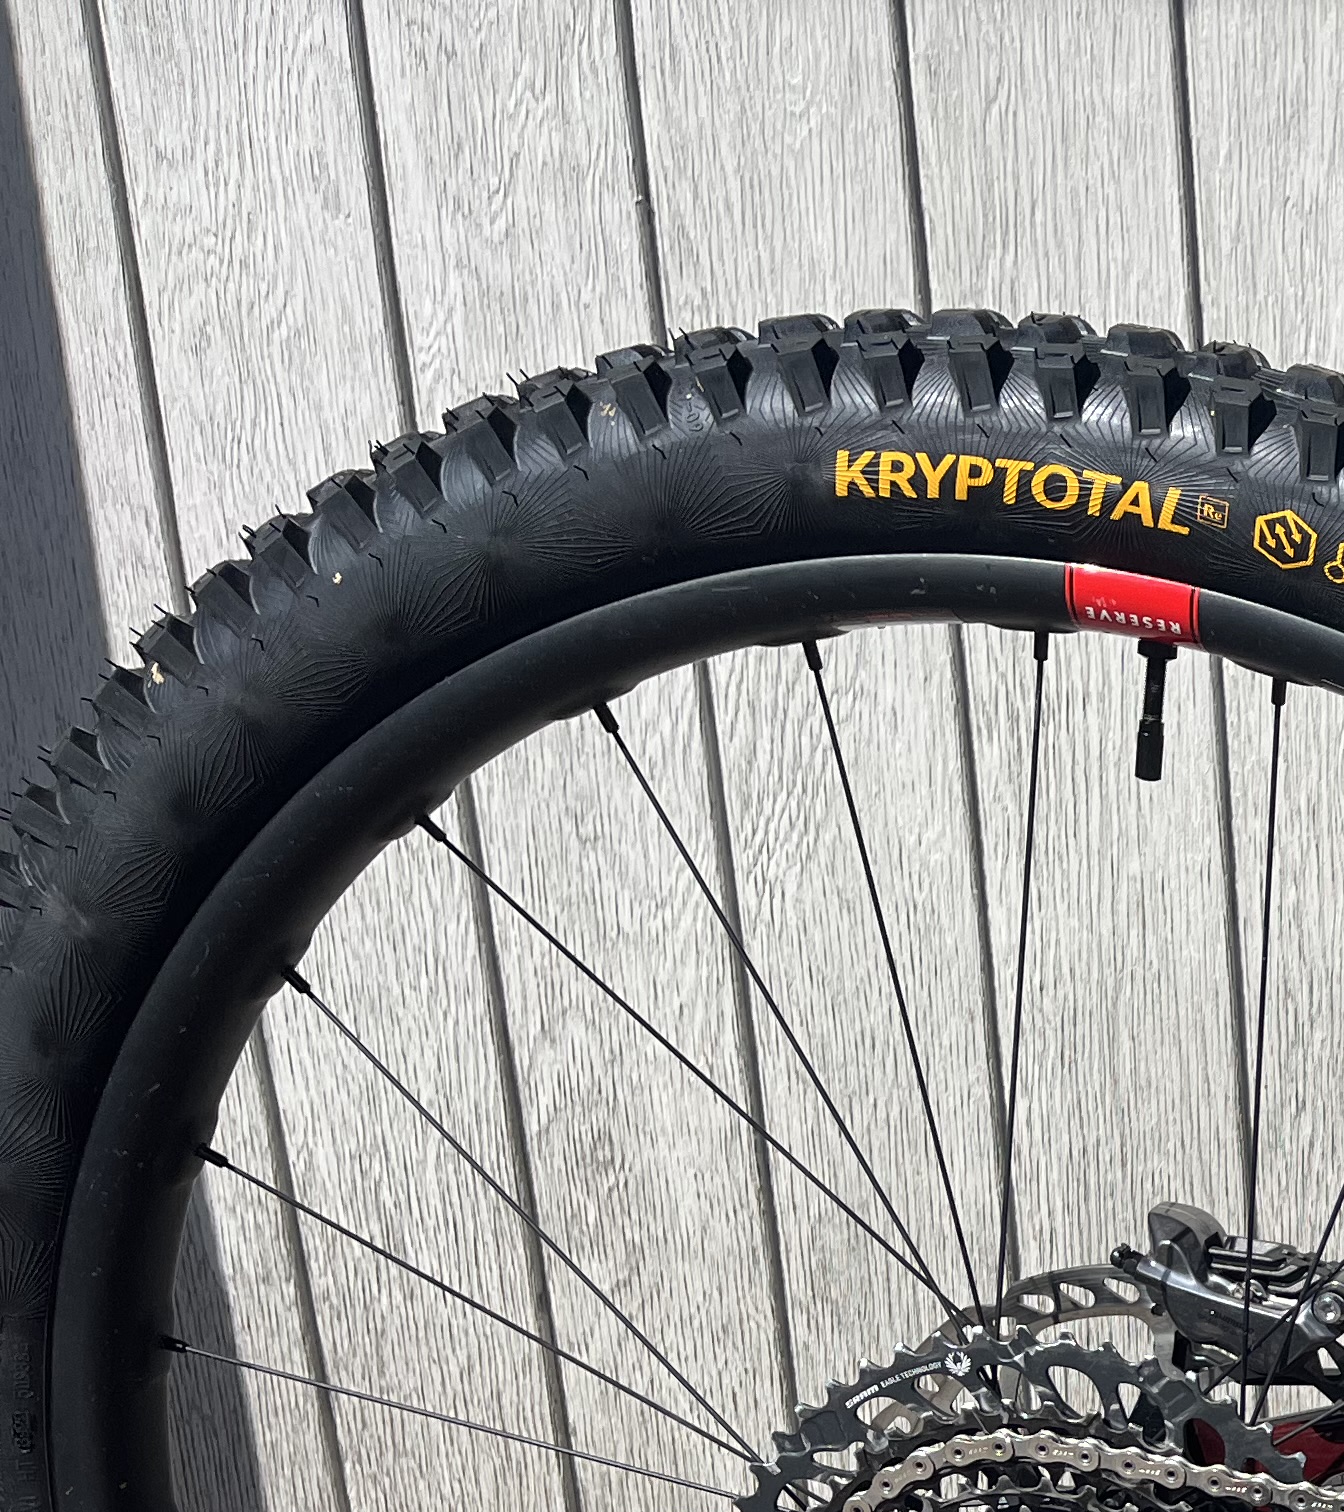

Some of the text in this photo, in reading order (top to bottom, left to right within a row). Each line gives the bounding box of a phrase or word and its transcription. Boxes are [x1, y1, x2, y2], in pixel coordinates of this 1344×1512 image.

[834, 448, 1192, 536] KRYPTOTAL
[1085, 606, 1182, 635] RESERVE
[844, 1384, 880, 1409] SRAM
[901, 1361, 942, 1382] TECHNOLOGY
